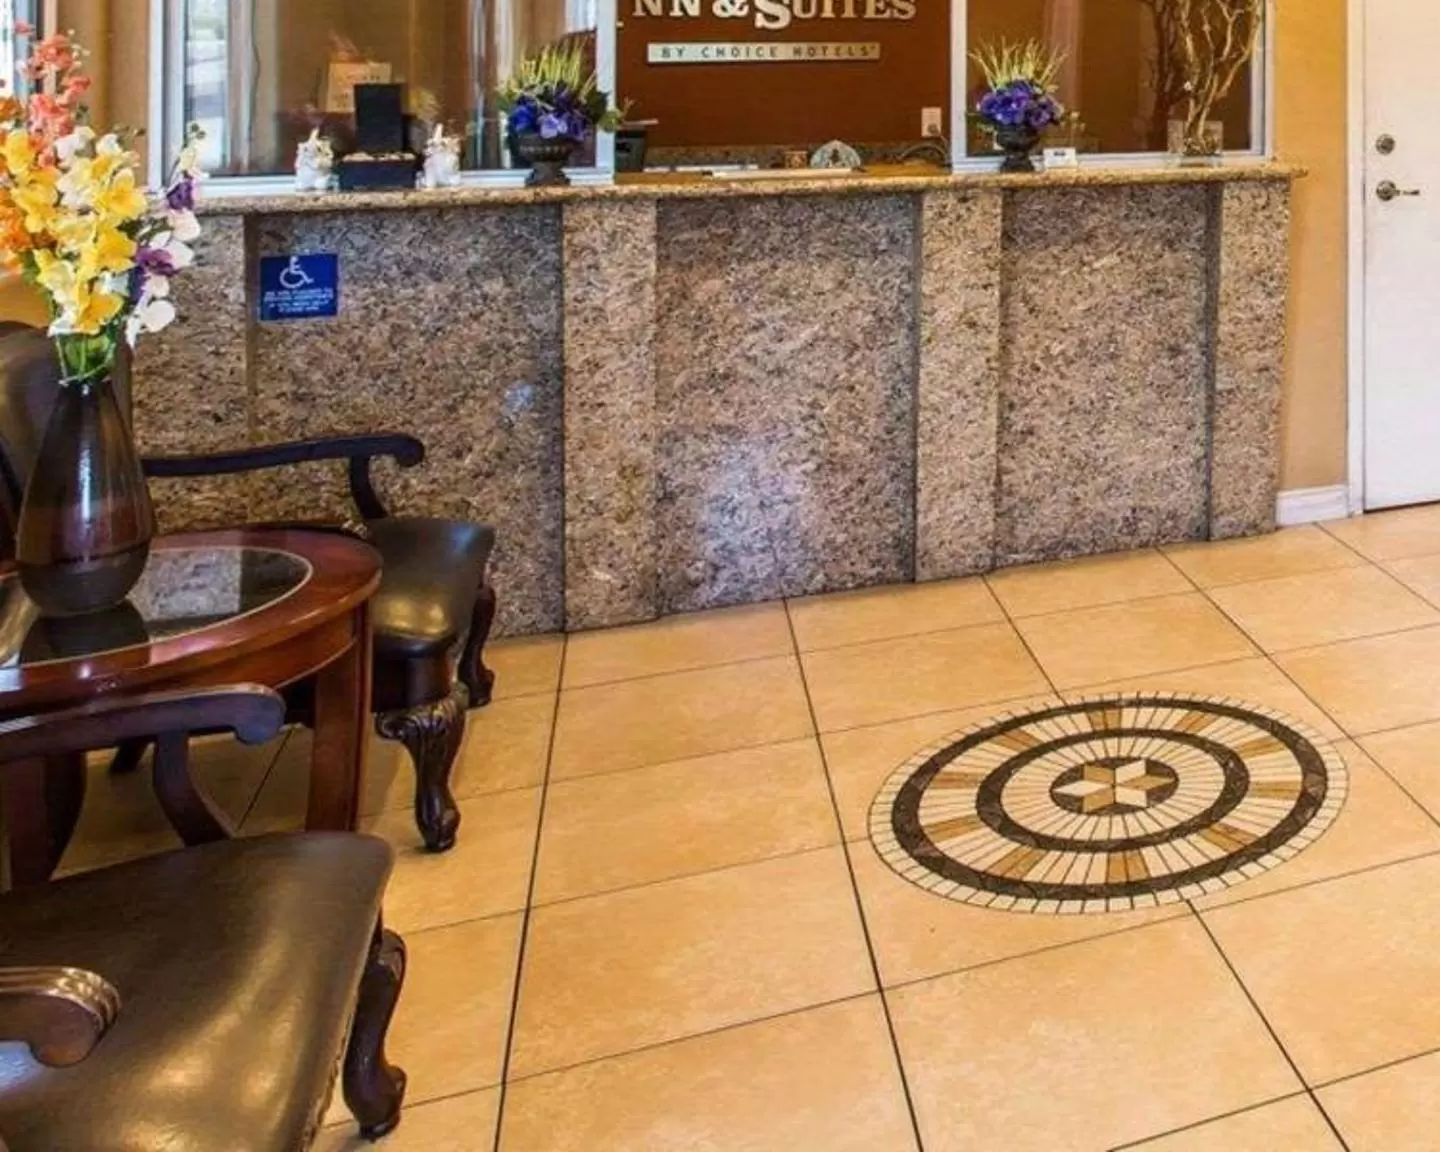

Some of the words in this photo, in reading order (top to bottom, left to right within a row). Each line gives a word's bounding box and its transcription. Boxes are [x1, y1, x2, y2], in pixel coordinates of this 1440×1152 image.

[660, 47, 686, 59] BY
[700, 46, 780, 59] CHOICE
[792, 45, 872, 58] HOTELS
